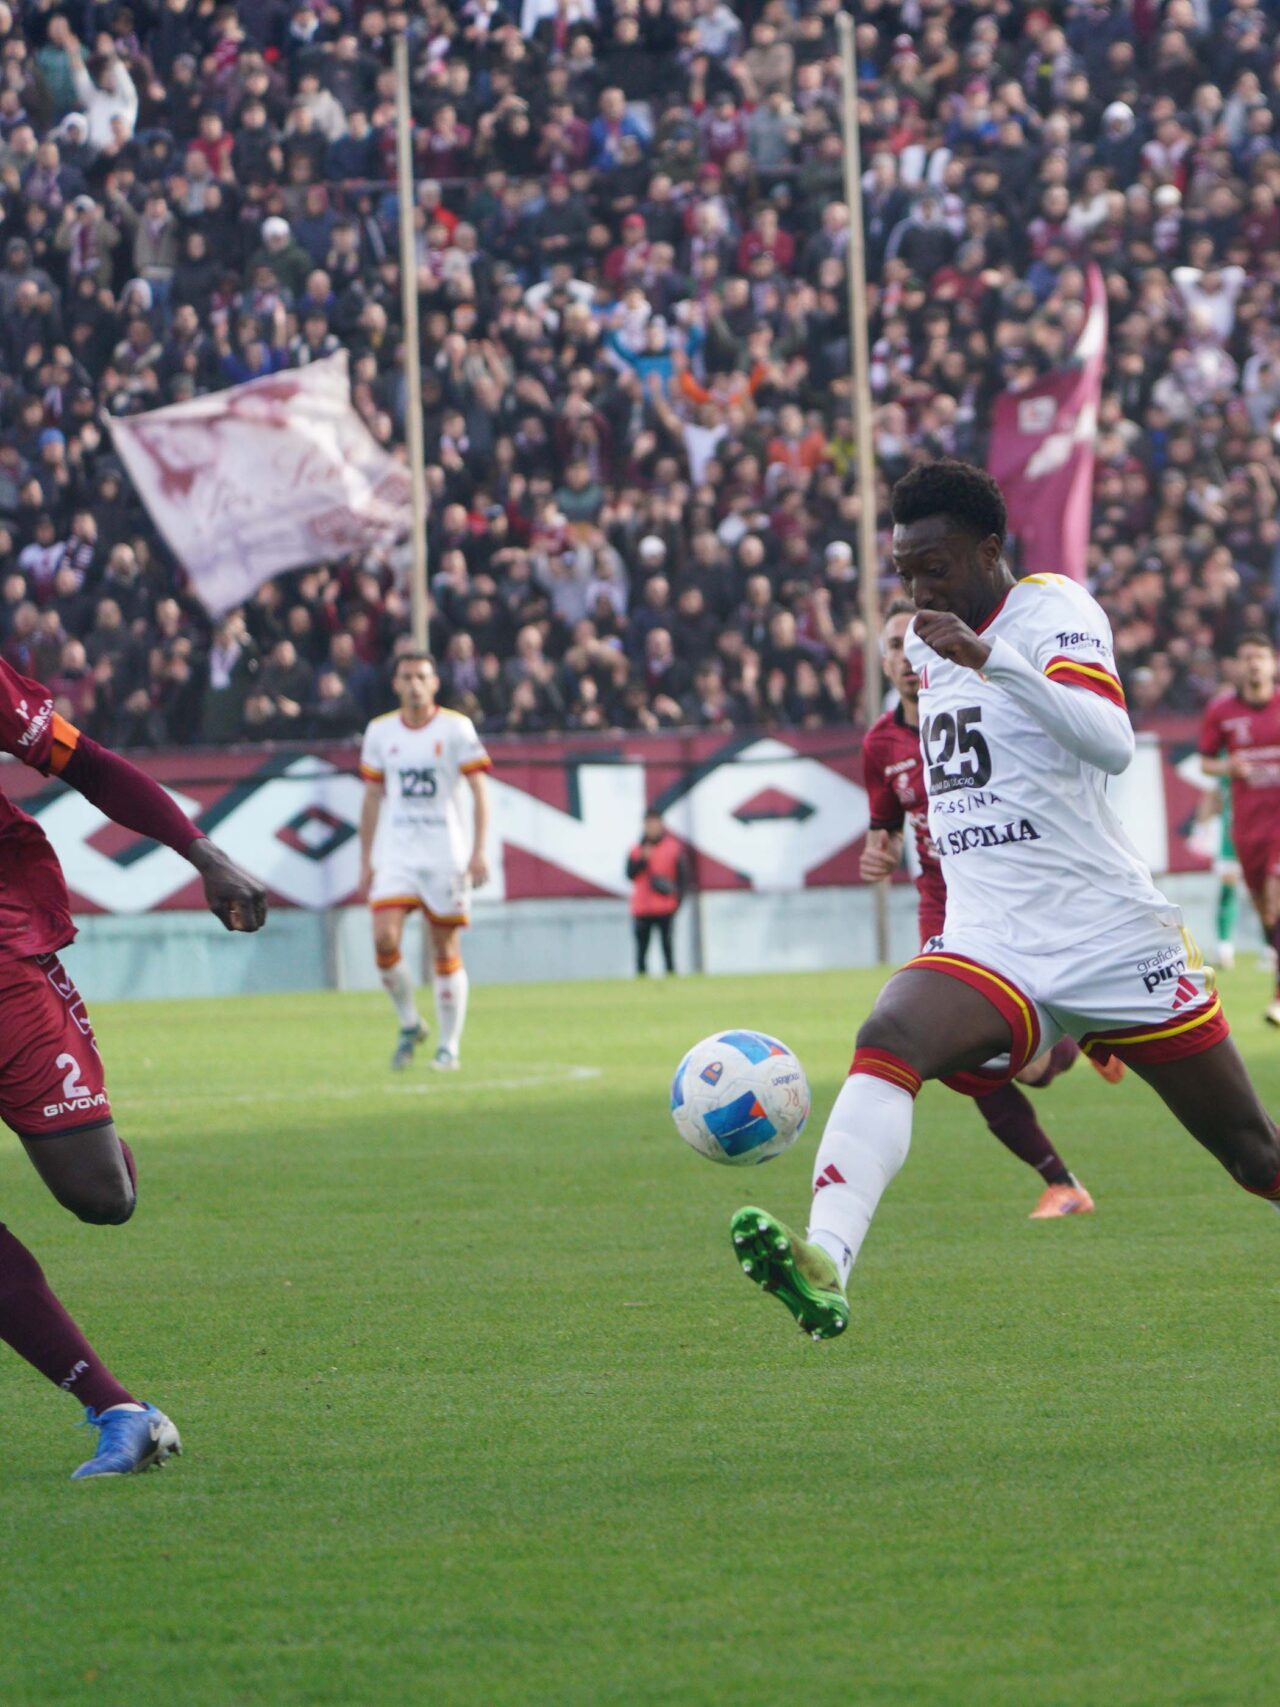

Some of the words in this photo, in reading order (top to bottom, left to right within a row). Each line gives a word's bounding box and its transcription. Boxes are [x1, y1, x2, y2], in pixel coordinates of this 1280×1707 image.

[921, 706, 992, 796] 125
[399, 767, 438, 798] 125
[933, 790, 1002, 814] ESSINA
[948, 819, 1041, 855] SICILIA
[55, 1052, 92, 1099] 2
[43, 1093, 107, 1117] GIVOVA
